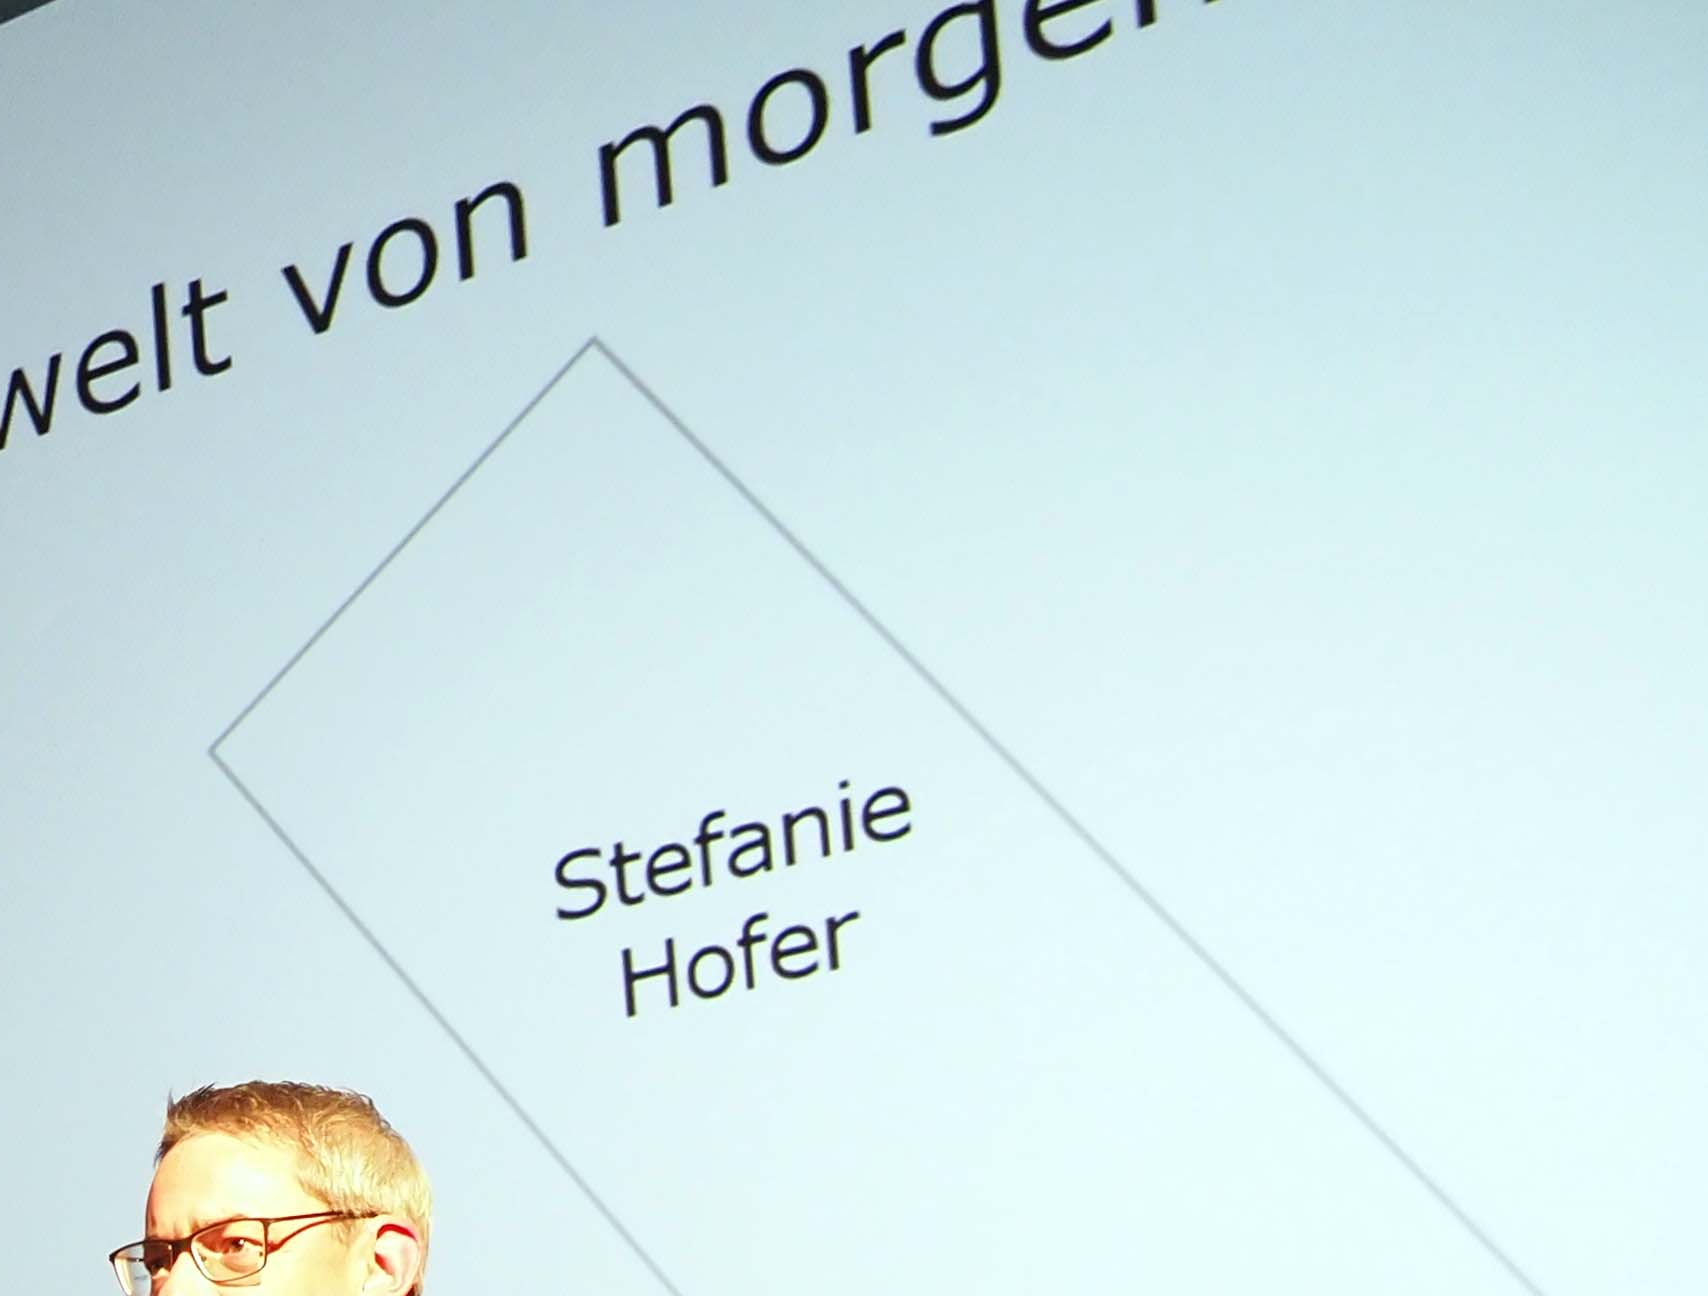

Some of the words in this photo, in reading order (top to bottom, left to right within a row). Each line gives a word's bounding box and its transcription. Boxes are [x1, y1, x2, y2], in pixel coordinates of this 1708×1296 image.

[281, 181, 528, 335] von
[554, 779, 912, 921] Stefanie
[621, 911, 860, 1018] Hofer
